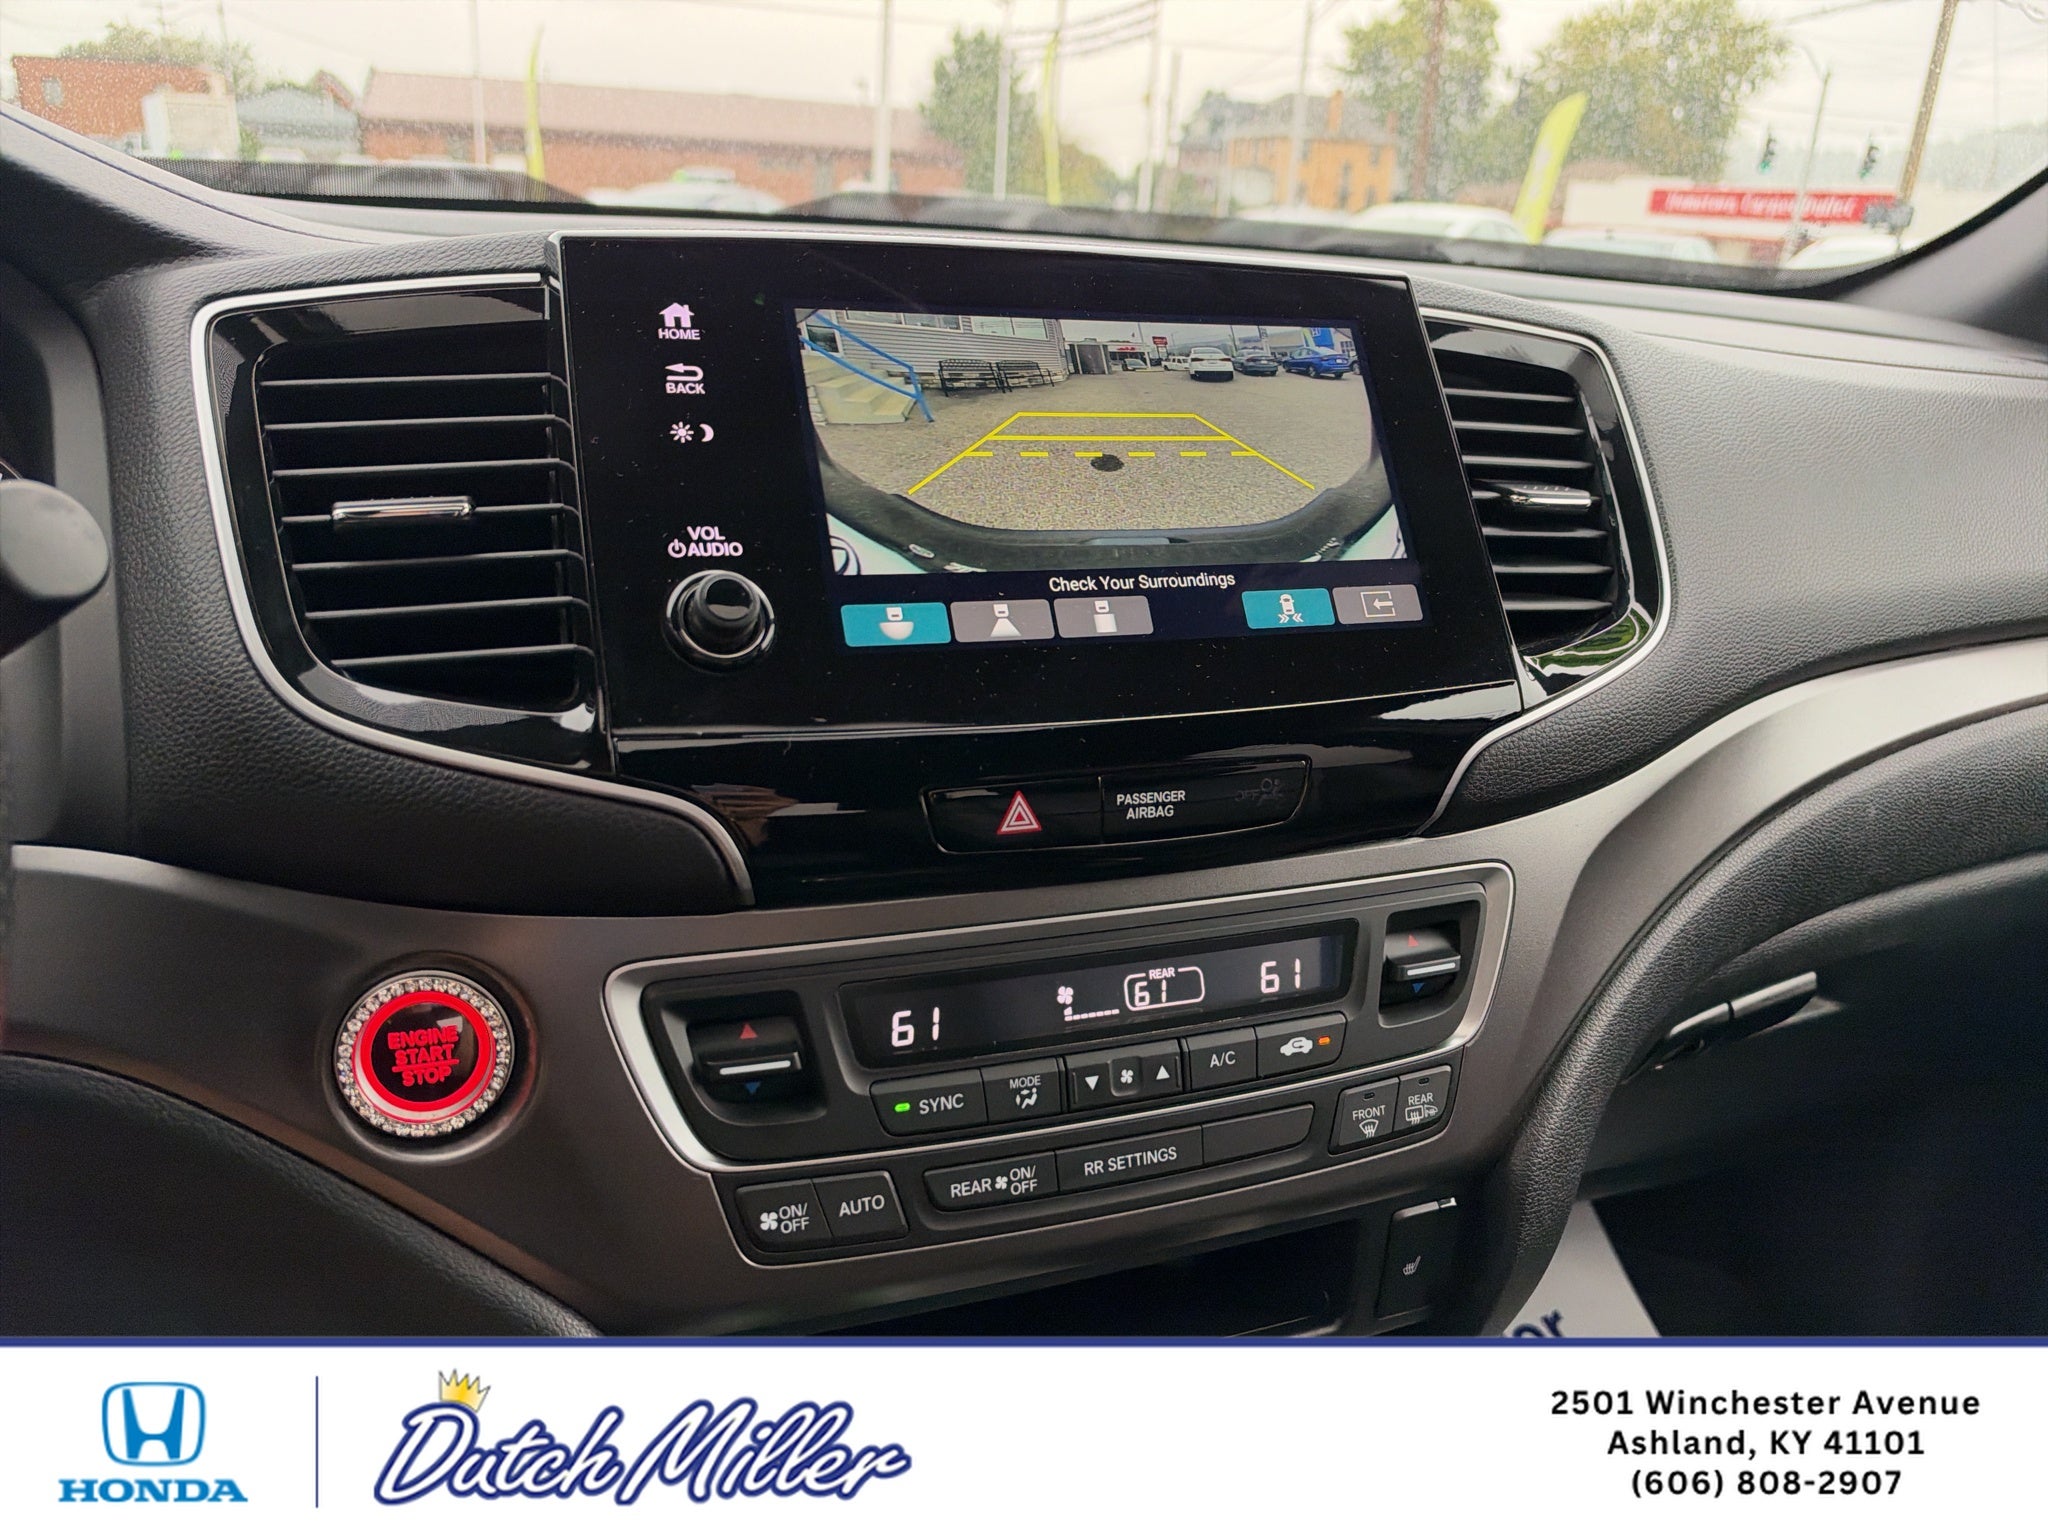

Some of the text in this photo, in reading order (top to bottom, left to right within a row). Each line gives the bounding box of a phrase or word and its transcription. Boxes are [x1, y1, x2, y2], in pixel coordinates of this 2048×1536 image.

[658, 328, 701, 340] HOME
[665, 382, 706, 395] BACK
[687, 526, 726, 541] VOL
[687, 541, 743, 557] AUDIO
[1049, 572, 1236, 593] Check Your Surroundings
[1116, 790, 1186, 806] PASSENGER
[1126, 804, 1175, 821] AIRBAG
[1148, 967, 1176, 979] REAR
[1260, 957, 1302, 994] 61
[1134, 979, 1168, 1007] 61
[891, 1006, 941, 1047] 61
[387, 1025, 459, 1049] ENGINE
[395, 1044, 455, 1066] START
[1210, 1051, 1237, 1068] A/C
[402, 1065, 452, 1087] STOP
[1009, 1075, 1042, 1089] MODE
[919, 1093, 965, 1115] SYNC
[1407, 1092, 1434, 1105] REAR
[1352, 1104, 1386, 1120] FRONT
[1084, 1146, 1178, 1176] RR SETTINGS
[950, 1165, 1037, 1199] REAR ON/
[1010, 1178, 1038, 1195] OFF
[778, 1203, 808, 1219] ON/
[839, 1194, 886, 1218] AUTO
[780, 1216, 810, 1234] OFF
